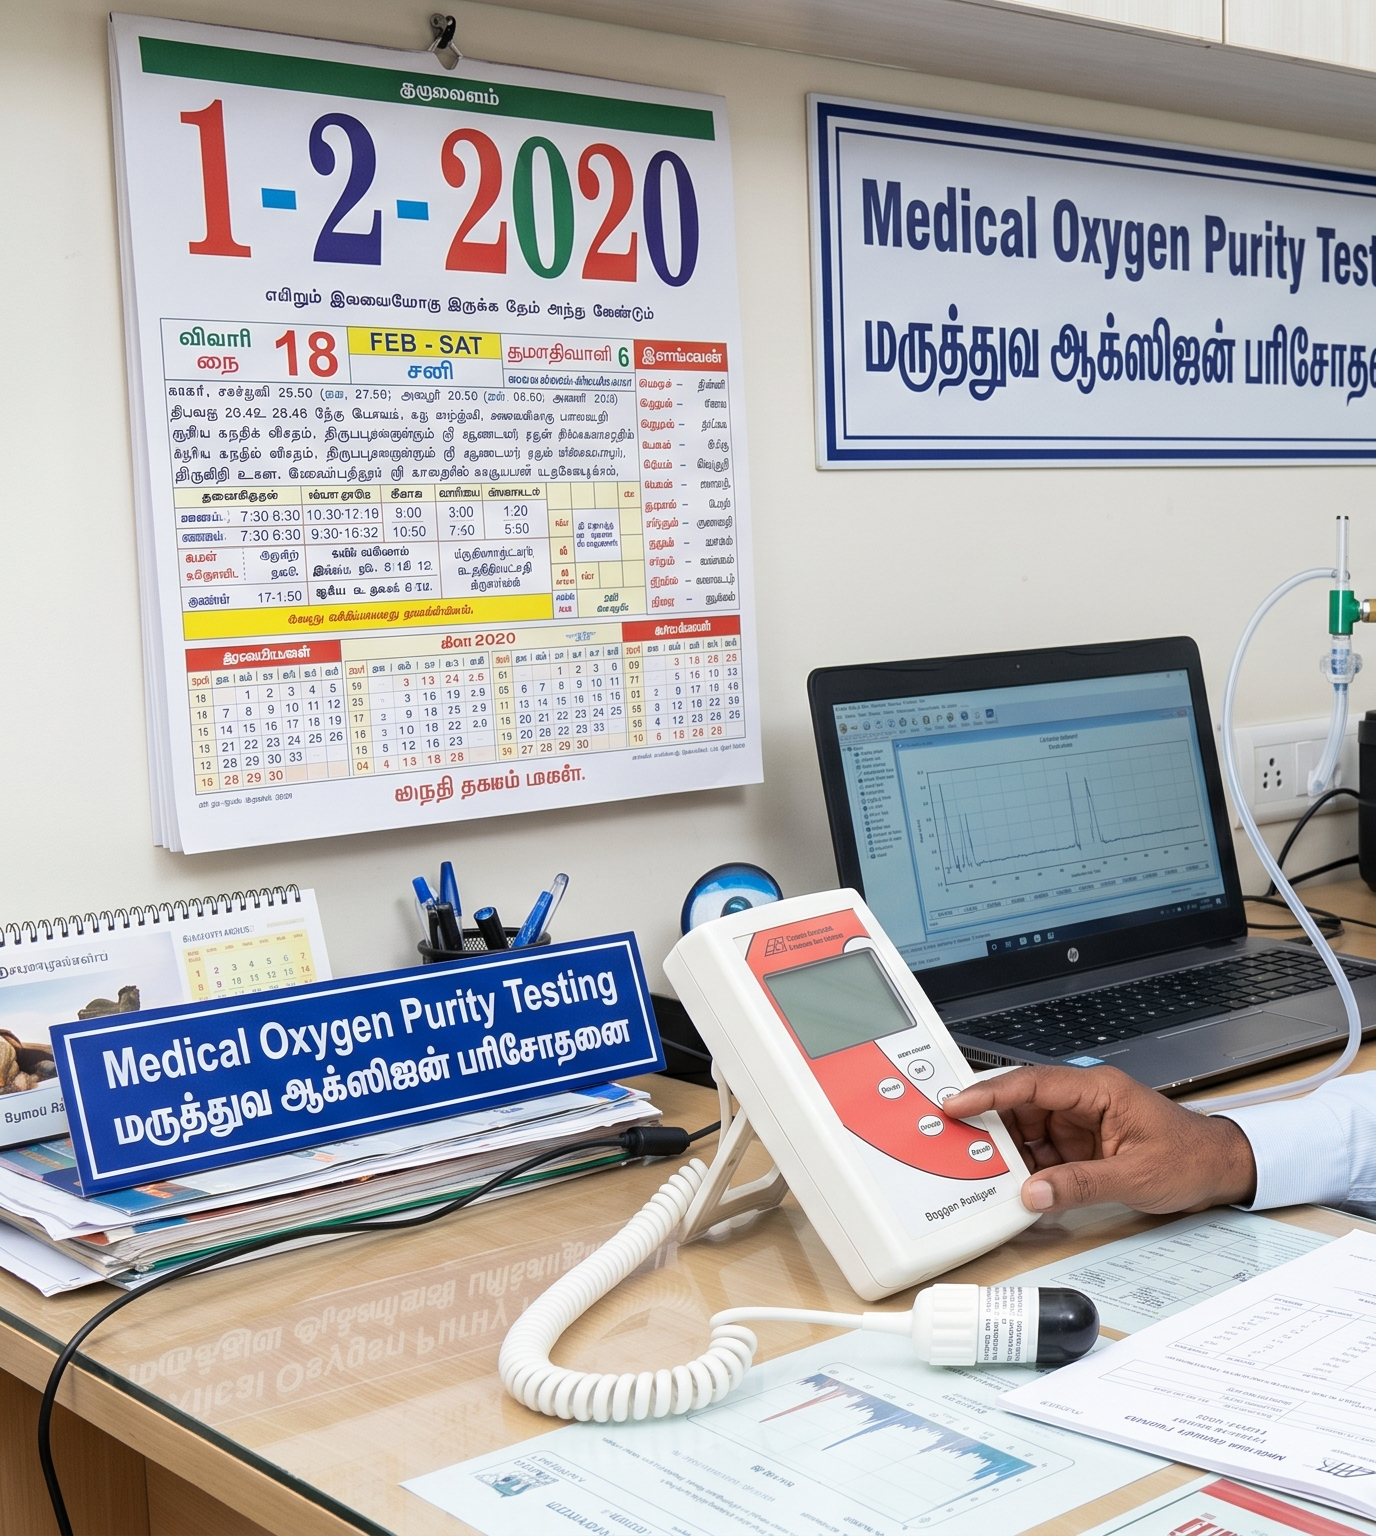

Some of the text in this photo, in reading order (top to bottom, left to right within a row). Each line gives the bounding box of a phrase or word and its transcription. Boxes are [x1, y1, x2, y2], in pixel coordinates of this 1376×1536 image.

[180, 98, 700, 288] 1-2-2020
[862, 178, 1037, 260] Medical
[1053, 199, 1190, 282] Oxygen
[1205, 214, 1306, 294] Purity
[370, 333, 417, 352] FEB
[440, 335, 482, 355] SAT
[275, 330, 339, 378] 18
[618, 347, 630, 367] 6
[864, 303, 1039, 402] மருத்துவ
[1051, 312, 1236, 395] ஆக்ஸிஜன்
[407, 361, 453, 380] சனி
[448, 391, 478, 401] 20.50
[241, 511, 268, 522] 7:30
[448, 506, 474, 518] 3:00
[503, 505, 528, 517] 1:20
[241, 529, 301, 542] 7:30 6:30
[393, 526, 426, 538] 10:50
[475, 632, 516, 647] 2020
[558, 664, 599, 675] 1 2 3
[403, 674, 459, 687] 3 13 24
[522, 677, 619, 693] 6 7 8 9 10 11
[245, 684, 336, 699] 1 2 3 4 5
[405, 690, 461, 703] 3 16 19
[691, 685, 701, 693] 17
[222, 699, 340, 718] 7 8 9 10 11 12
[519, 697, 566, 708] 13 14 15
[672, 698, 720, 710] 12 22
[353, 705, 461, 722] 17 9 18 25
[520, 706, 622, 724] 20 21 22 23 24 25
[655, 716, 684, 726] 4 12
[198, 715, 342, 736] 15 14 15 16 17 18 19
[399, 721, 462, 735] 10 22
[520, 723, 605, 739] 20 22 23 33
[222, 732, 343, 752] 21 22 23 24 25 26
[402, 737, 463, 750] 12 16 23
[521, 740, 589, 754] 27 29 30
[223, 752, 302, 769] 28 29 30 33
[383, 752, 464, 768] 4 18 28
[224, 771, 284, 785] 28 29 30
[103, 969, 618, 1090] Medical Oxygen Purity Testing
[114, 1019, 631, 1147] மருத்துவ ஆக்ஸிஜன் பரிசோதனை
